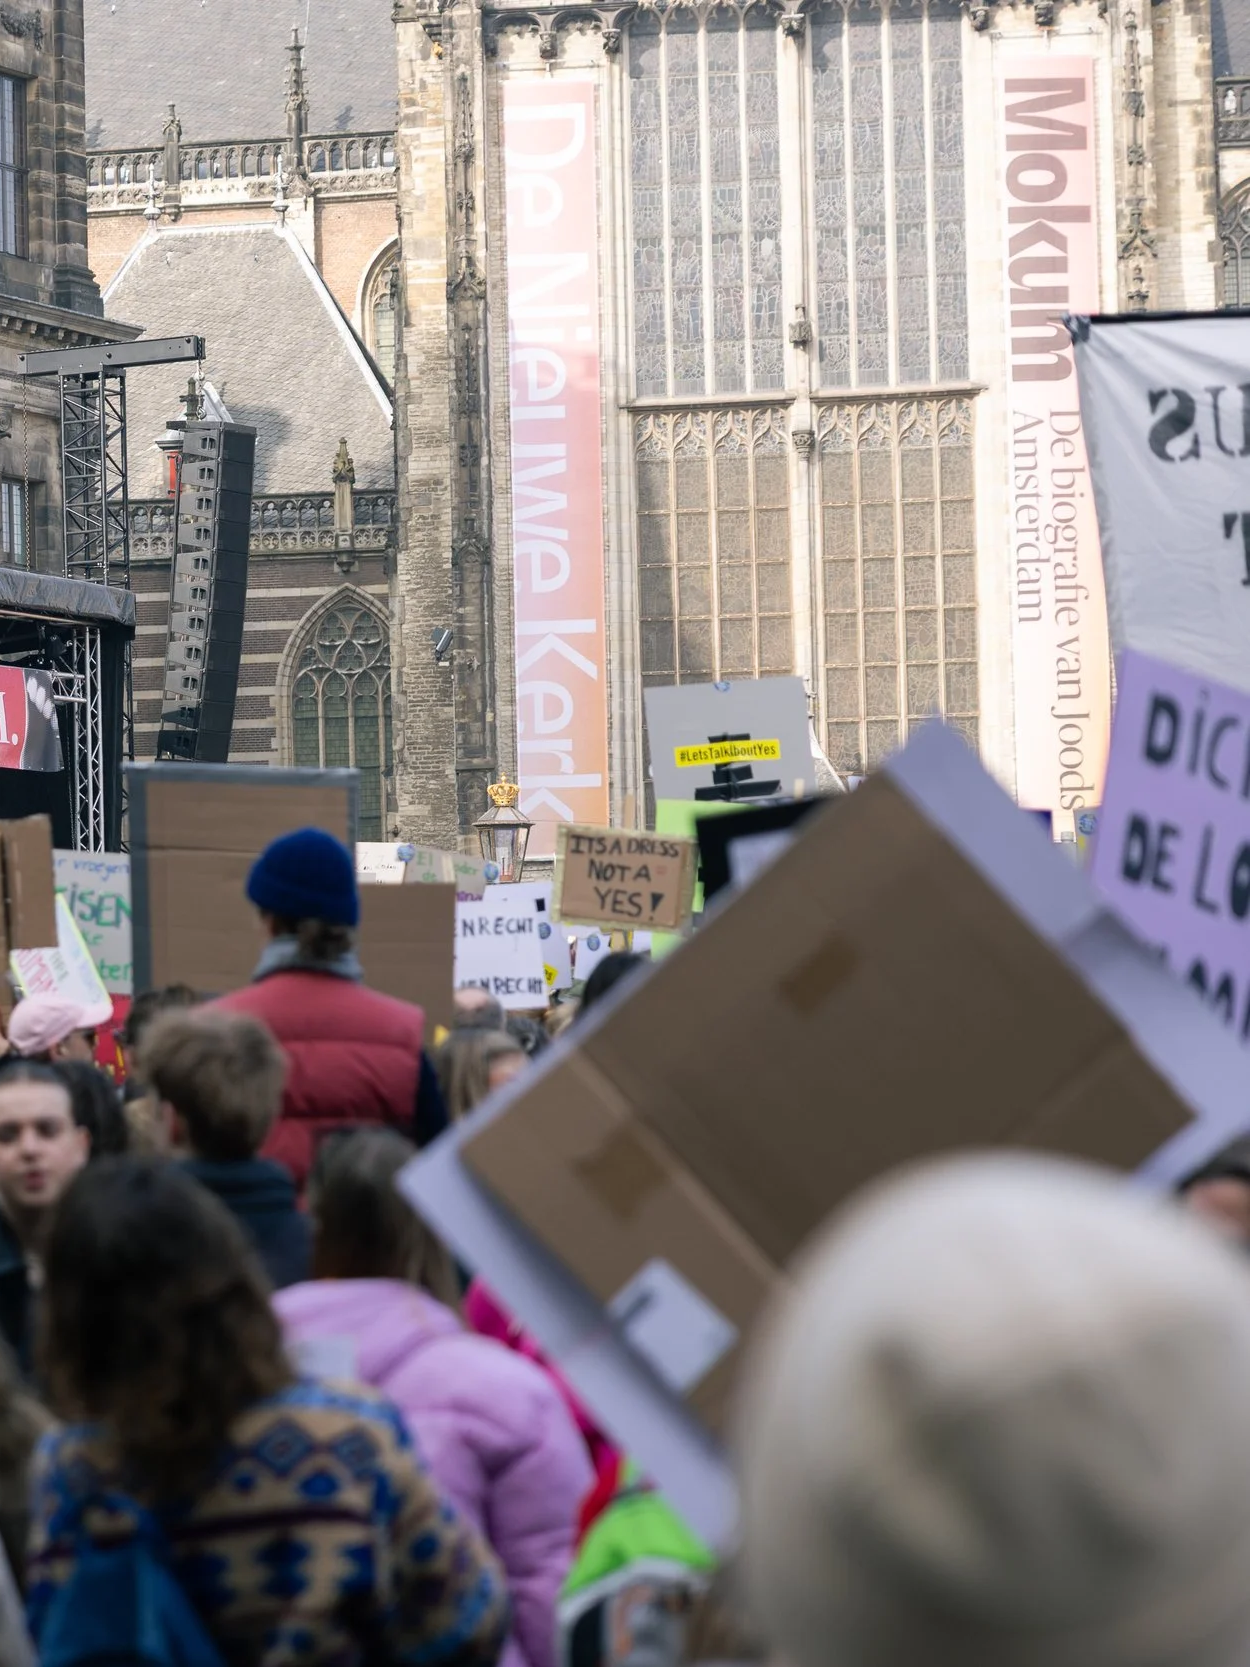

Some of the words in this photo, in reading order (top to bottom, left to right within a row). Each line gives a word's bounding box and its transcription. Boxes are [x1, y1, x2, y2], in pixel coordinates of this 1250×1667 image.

[504, 102, 586, 228] De
[1004, 77, 1091, 382] Mokum
[507, 252, 592, 594] Nieuwe
[1049, 408, 1082, 458] De
[1012, 409, 1051, 624] Amsterdam
[1043, 466, 1090, 627] biografie
[516, 618, 602, 824] Kerk
[1055, 634, 1083, 700] van
[1050, 706, 1095, 811] Joods
[588, 859, 631, 883] NOT
[632, 864, 652, 883] A
[609, 838, 622, 856] A
[627, 838, 680, 858] DRESS
